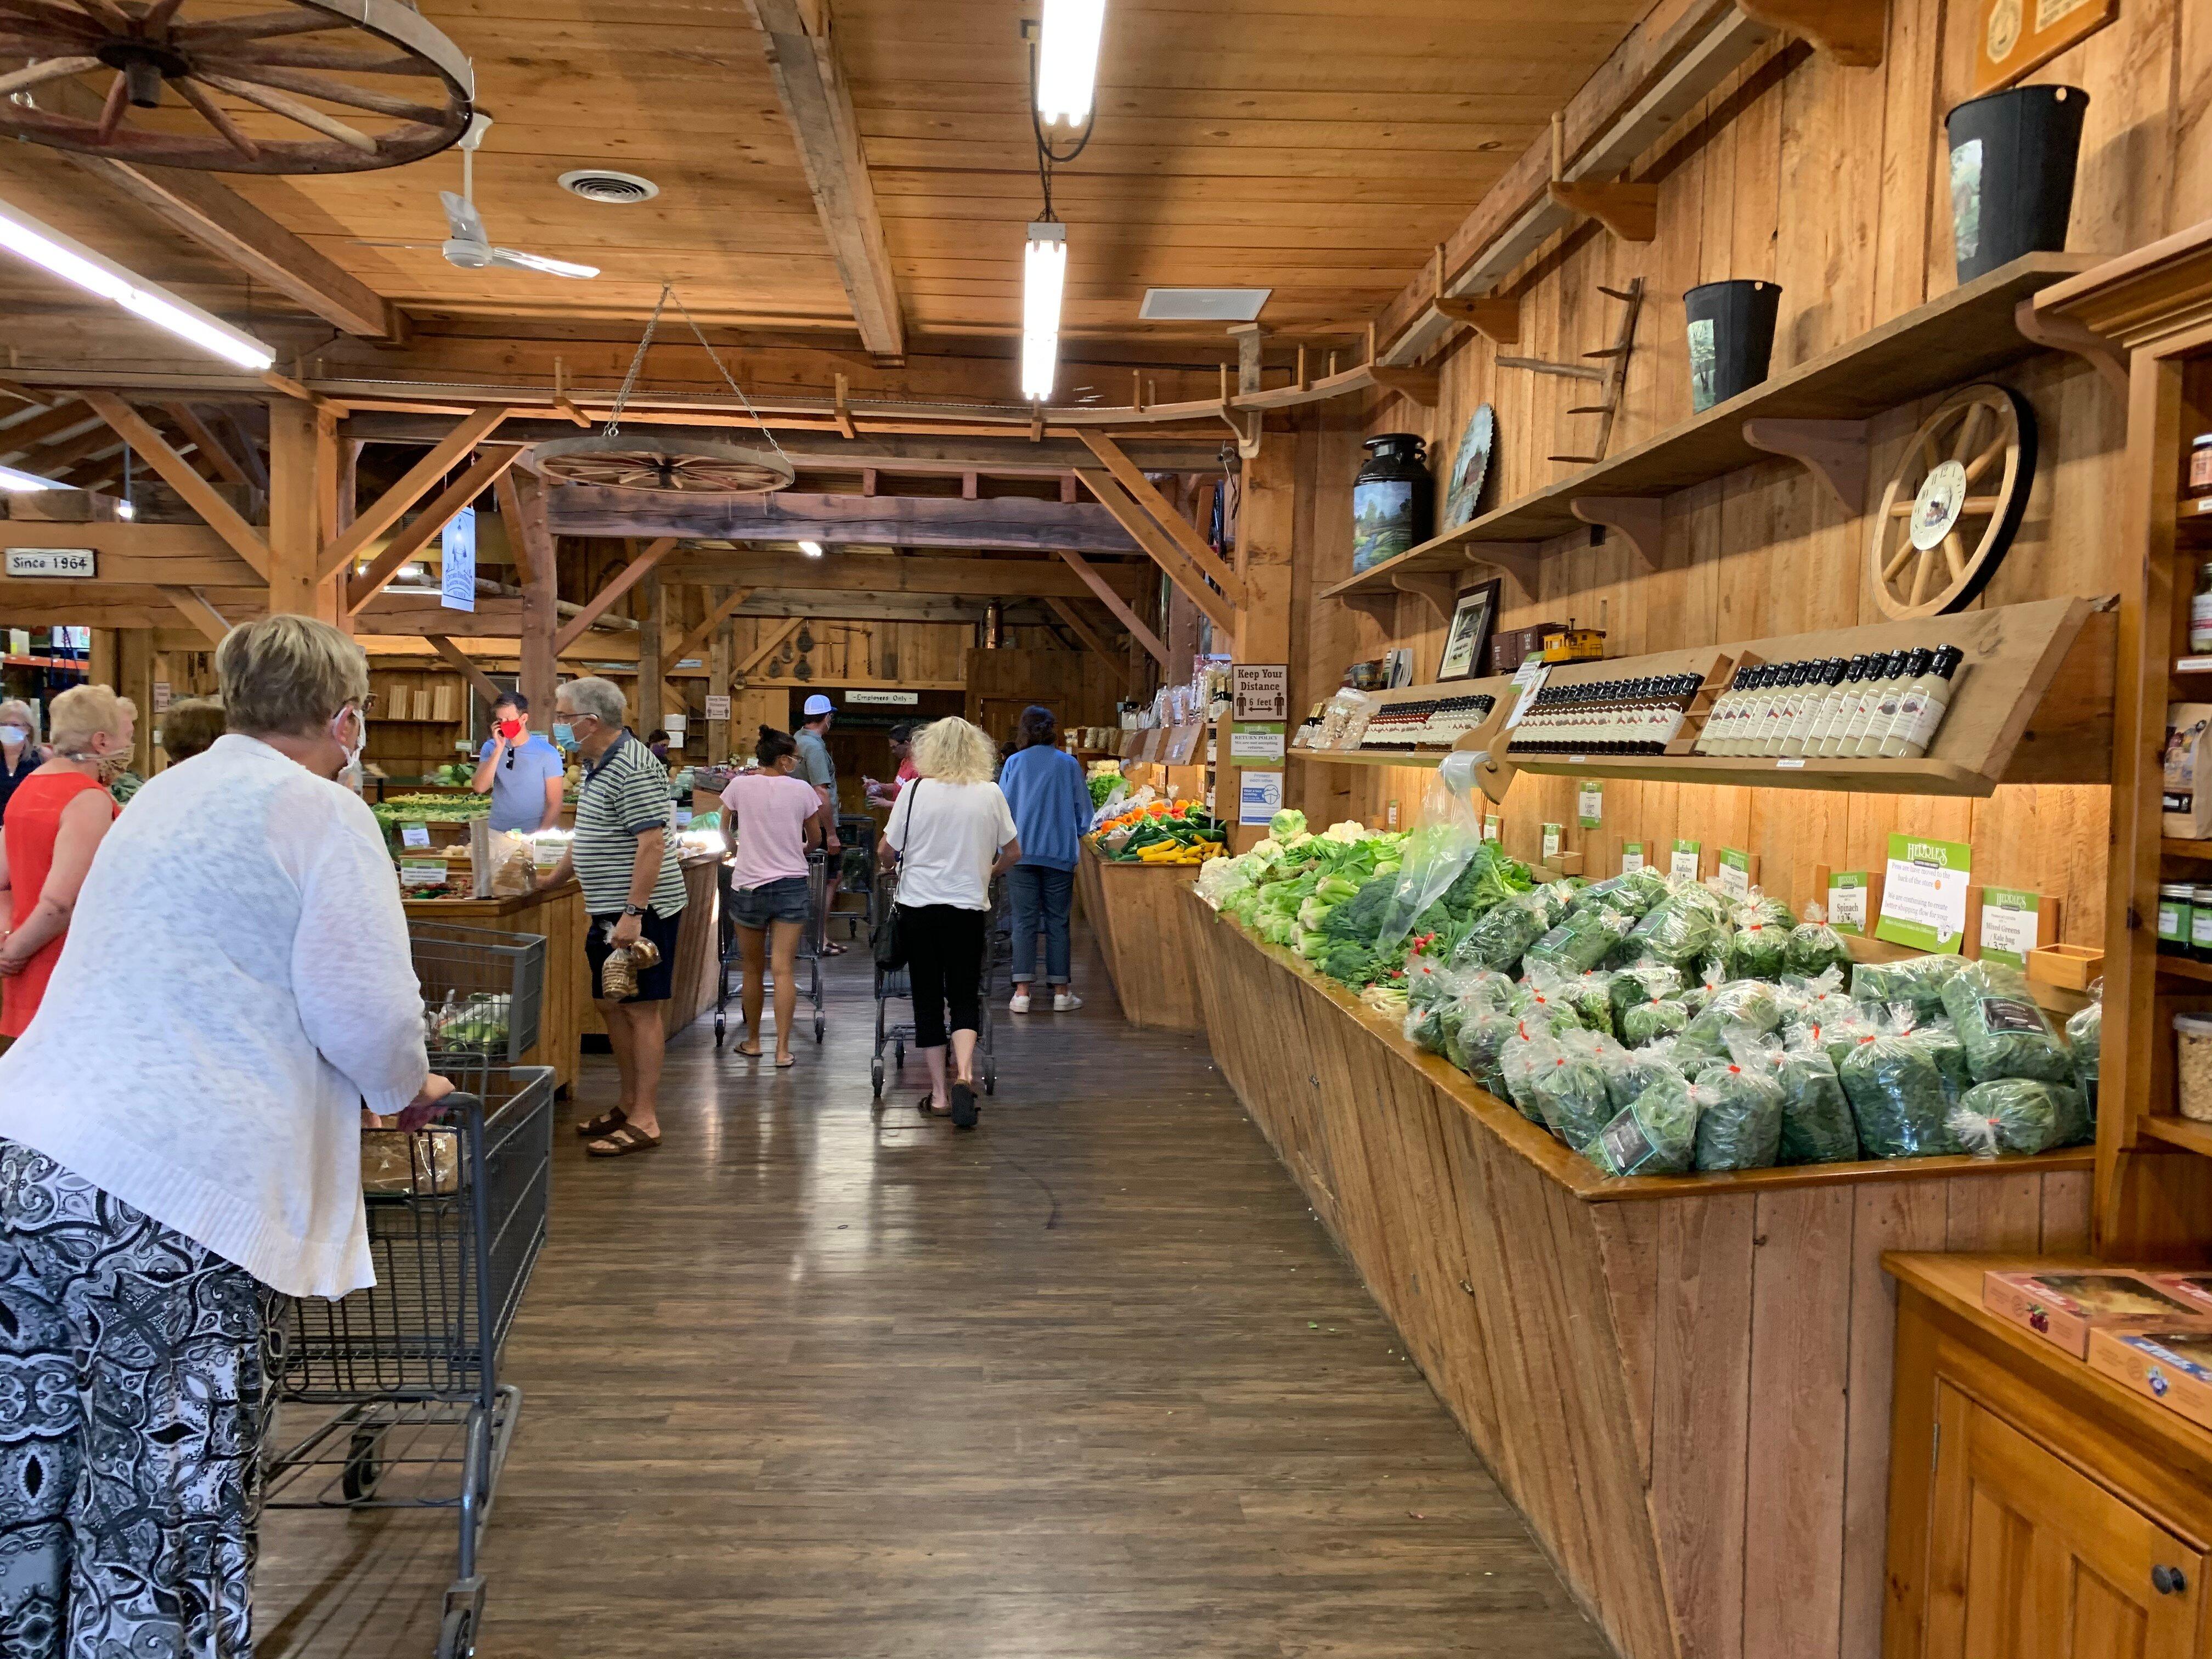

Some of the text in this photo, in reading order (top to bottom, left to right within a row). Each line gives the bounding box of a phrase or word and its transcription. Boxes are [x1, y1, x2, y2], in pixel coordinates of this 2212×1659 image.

[13, 557, 87, 570] Since 1964
[1238, 669, 1283, 680] Keep Your
[1240, 681, 1280, 690] Distance
[1249, 698, 1272, 706] 6 feet
[1907, 843, 1948, 866] HERRLE'S
[1898, 874, 1908, 883] back
[1921, 869, 1936, 877] moved
[1903, 895, 1927, 908] continuing
[1837, 902, 1858, 914] Spinach
[1885, 900, 1897, 910] better
[1898, 903, 1919, 916] shopping
[1986, 922, 2020, 934] Mixed Greens
[1994, 933, 2004, 941] Kale
[2005, 935, 2015, 945] bag
